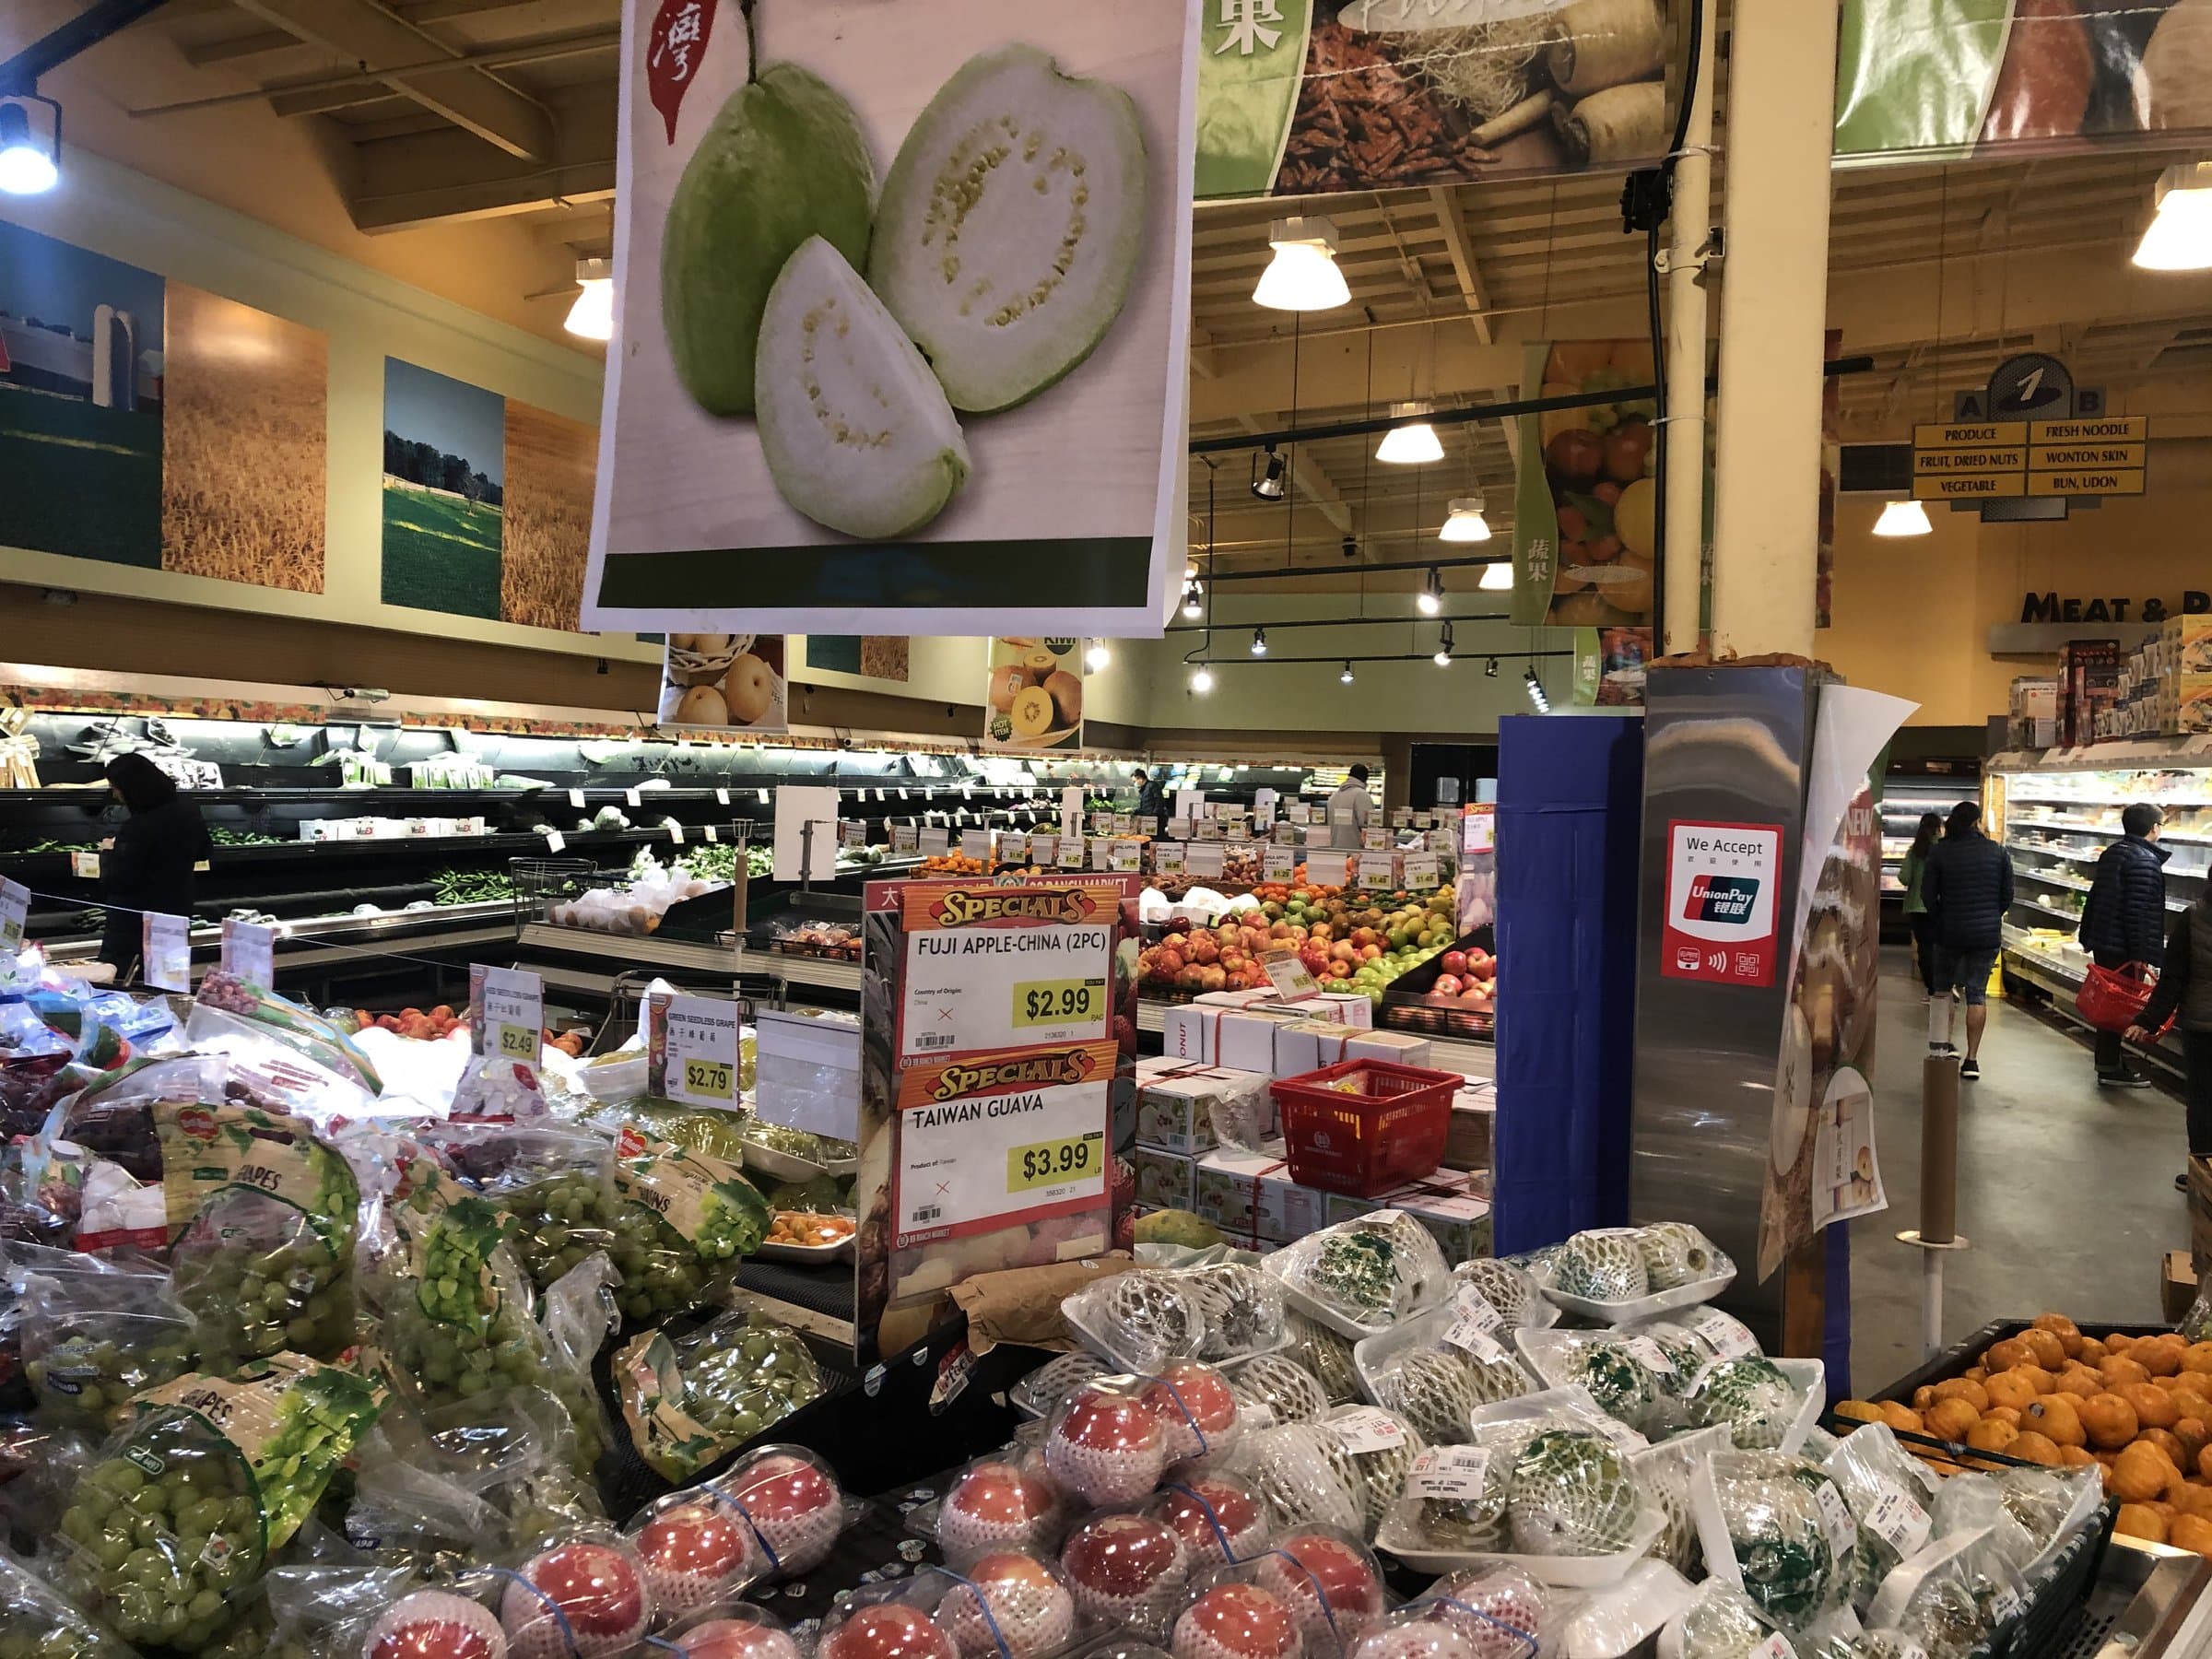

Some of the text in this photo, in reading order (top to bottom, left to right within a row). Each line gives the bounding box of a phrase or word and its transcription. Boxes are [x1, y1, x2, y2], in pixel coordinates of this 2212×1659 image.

[2017, 368, 2044, 402] 1
[1959, 396, 1982, 417] A
[2079, 391, 2100, 412] B
[1945, 428, 1997, 441] PRODUCE
[2046, 424, 2130, 438] FRESH NOODLE
[1920, 453, 2018, 468] FRUIT, DRIED NUTS
[2046, 450, 2128, 463] WONTON SKIN
[1941, 480, 1997, 492] VEGETABLE
[2053, 477, 2118, 490] BUN, UDON
[2142, 597, 2167, 623] &
[994, 719, 1007, 729] HOT
[994, 726, 1009, 737] ITEM
[1687, 838, 1762, 856] We Accept
[1692, 886, 1754, 906] UnionPay
[938, 890, 1087, 926] SPECIALS
[919, 932, 1106, 955] FUJI APPLE-CHINA (2PC)
[1027, 988, 1090, 1020] $2.99
[668, 1013, 735, 1029] GREEN SEEDLESS GRAPE
[502, 1032, 532, 1053] $2.49
[1179, 1022, 1187, 1059] ONUT
[688, 1065, 727, 1090] $2.79
[935, 1050, 1087, 1100] SPECIALS
[912, 1094, 1043, 1129] TAIWAN GUAVA
[911, 1161, 931, 1171] Product
[1023, 1143, 1088, 1182] $3.99
